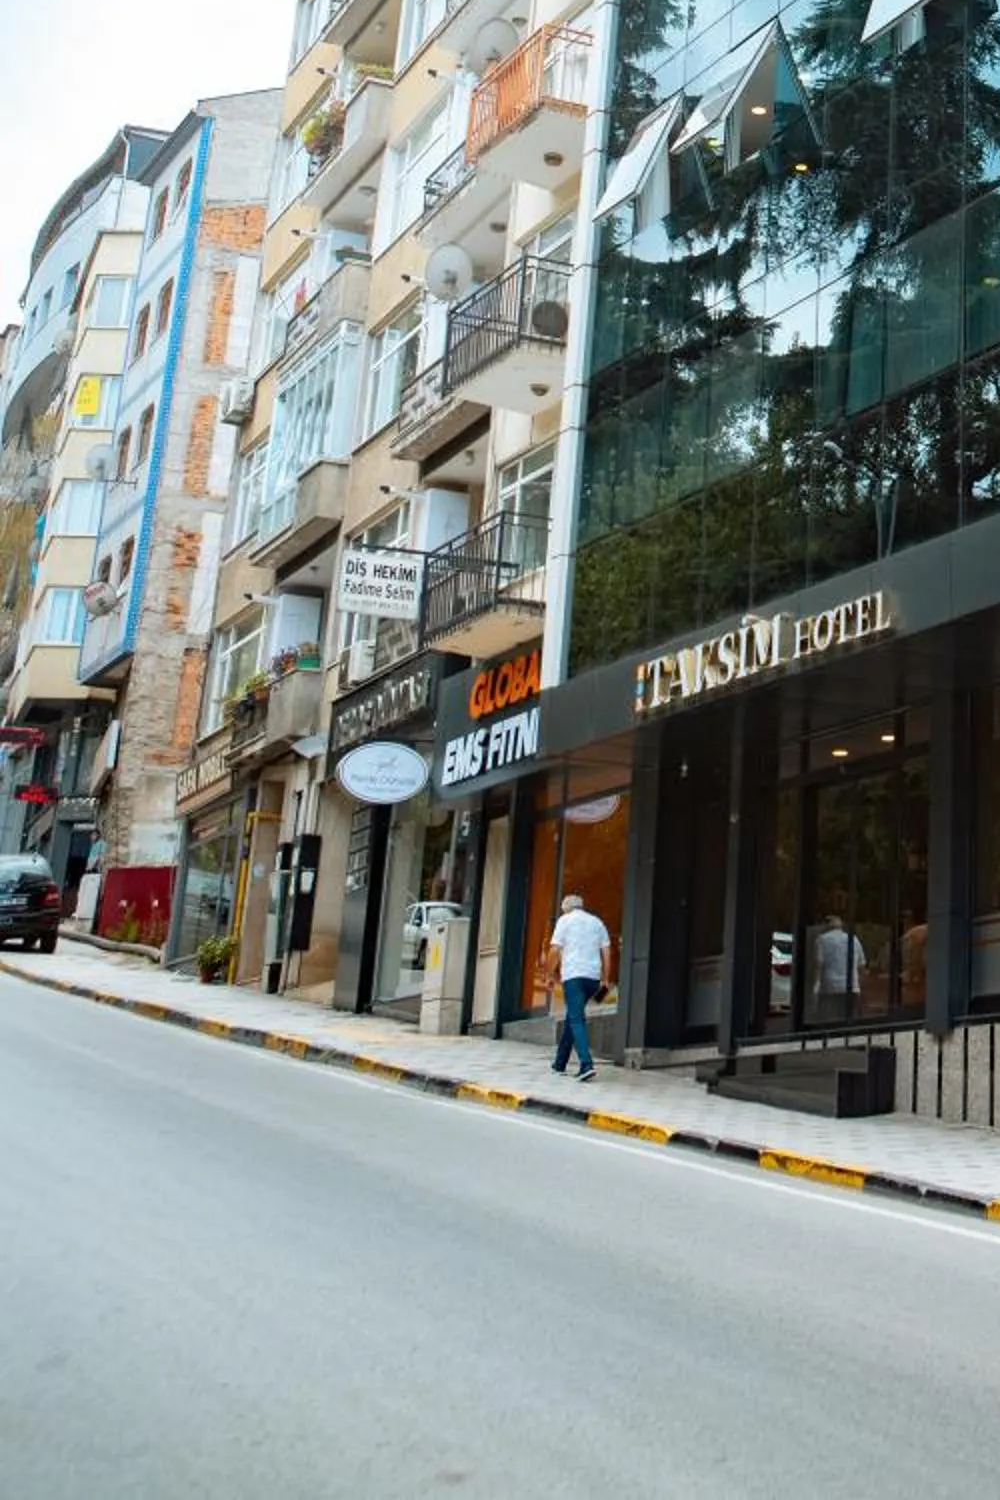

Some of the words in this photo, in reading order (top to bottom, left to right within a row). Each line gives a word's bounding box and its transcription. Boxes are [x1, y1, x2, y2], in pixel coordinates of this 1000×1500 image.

[373, 563, 417, 583] HEKİMİ
[793, 590, 891, 659] HOTEL
[469, 650, 541, 720] GLOBA
[441, 728, 488, 786] EMS
[486, 707, 540, 771] FITN
